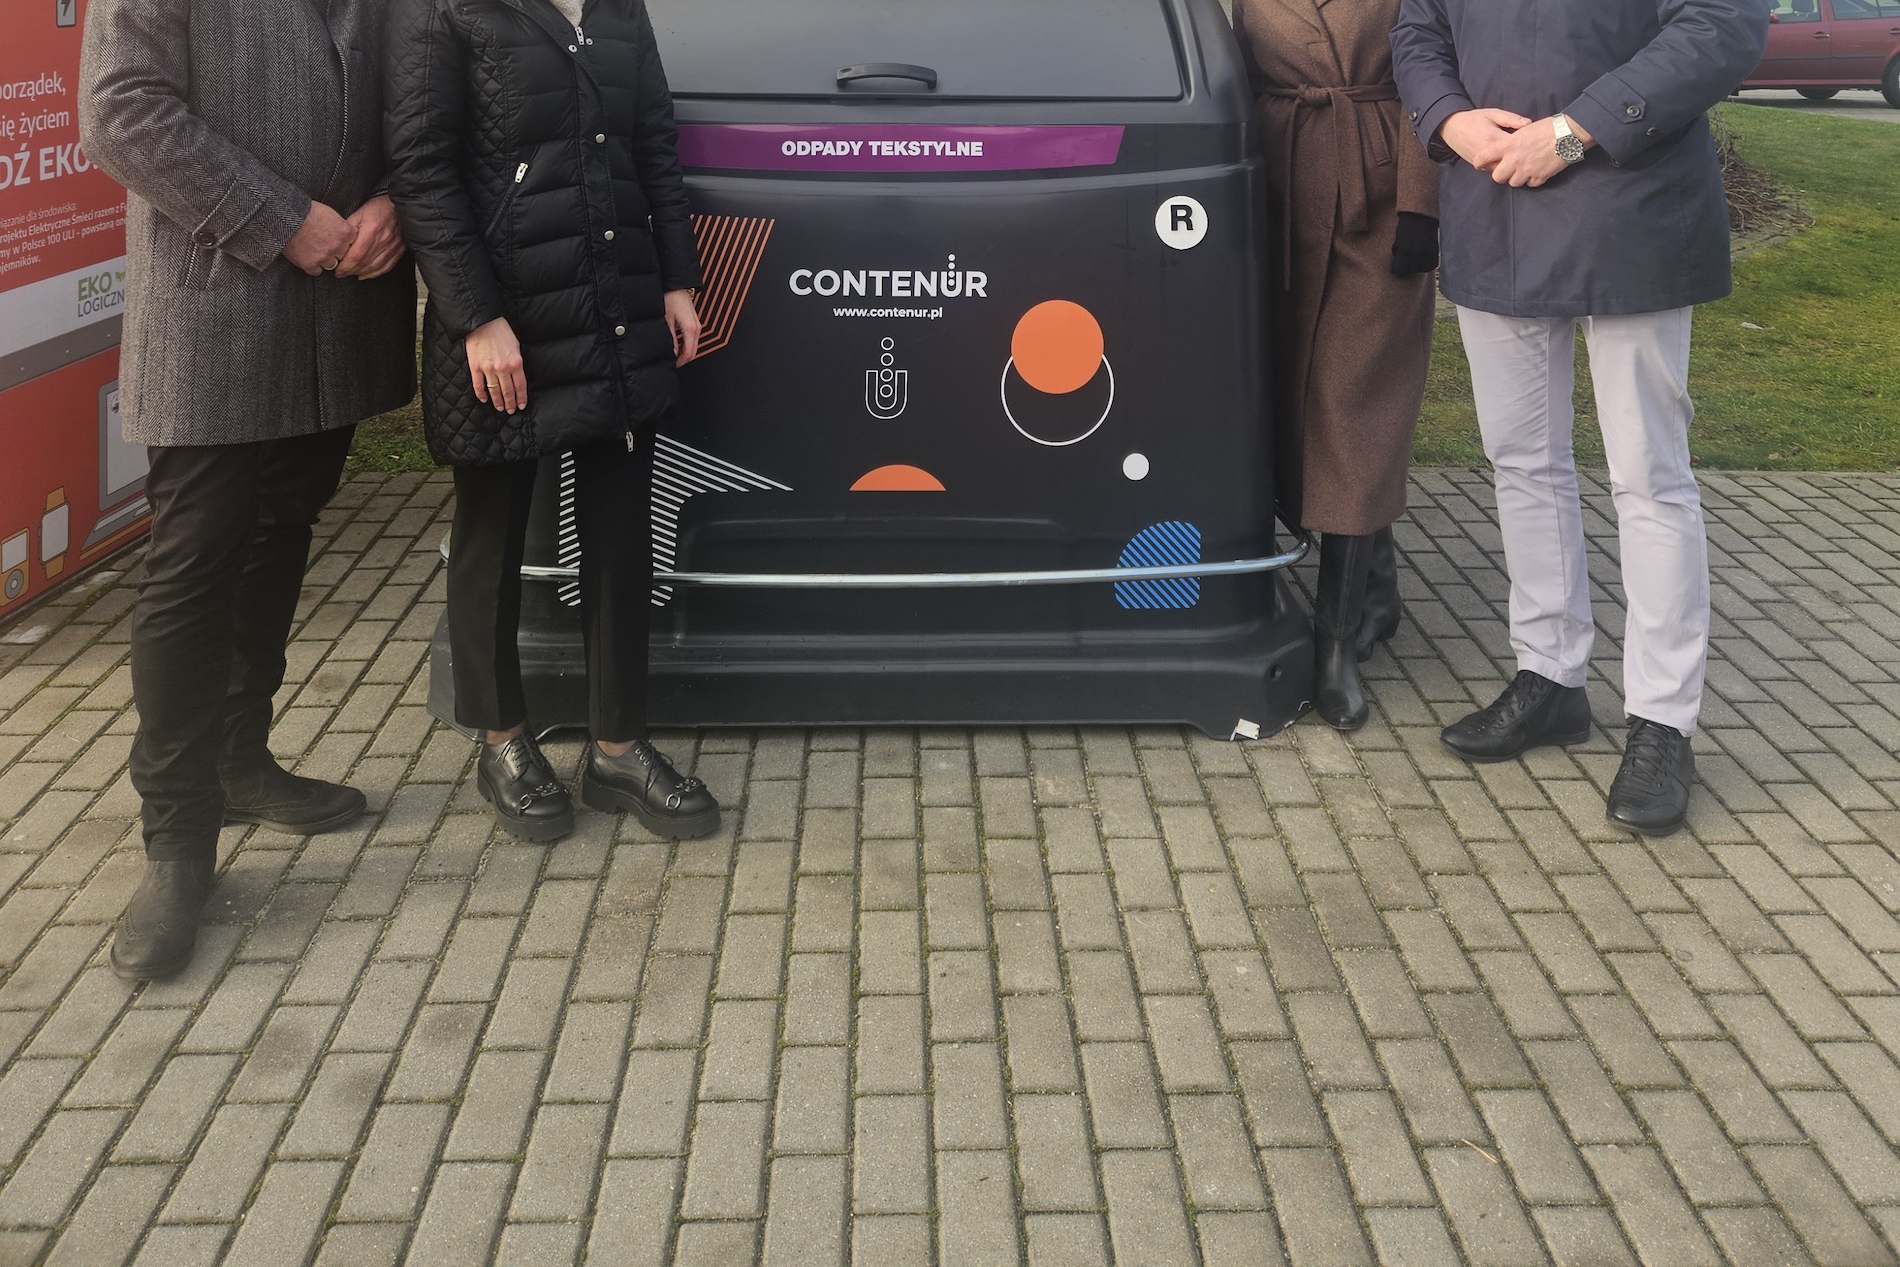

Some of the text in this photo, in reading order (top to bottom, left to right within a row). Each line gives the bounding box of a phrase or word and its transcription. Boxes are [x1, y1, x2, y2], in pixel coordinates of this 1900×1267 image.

[19, 109, 69, 138] życiem
[781, 140, 984, 156] ODPADY TEKSTYLNE
[28, 218, 71, 236] Elektryczne
[71, 209, 94, 225] Śmieci
[94, 206, 115, 219] razem
[1170, 204, 1194, 231] R
[22, 238, 46, 253] Polsce
[47, 232, 61, 245] 100
[81, 220, 115, 239] powstaną
[77, 271, 112, 302] EKO
[789, 254, 988, 298] CONTENUR
[833, 306, 943, 321] www.contenur.pl
